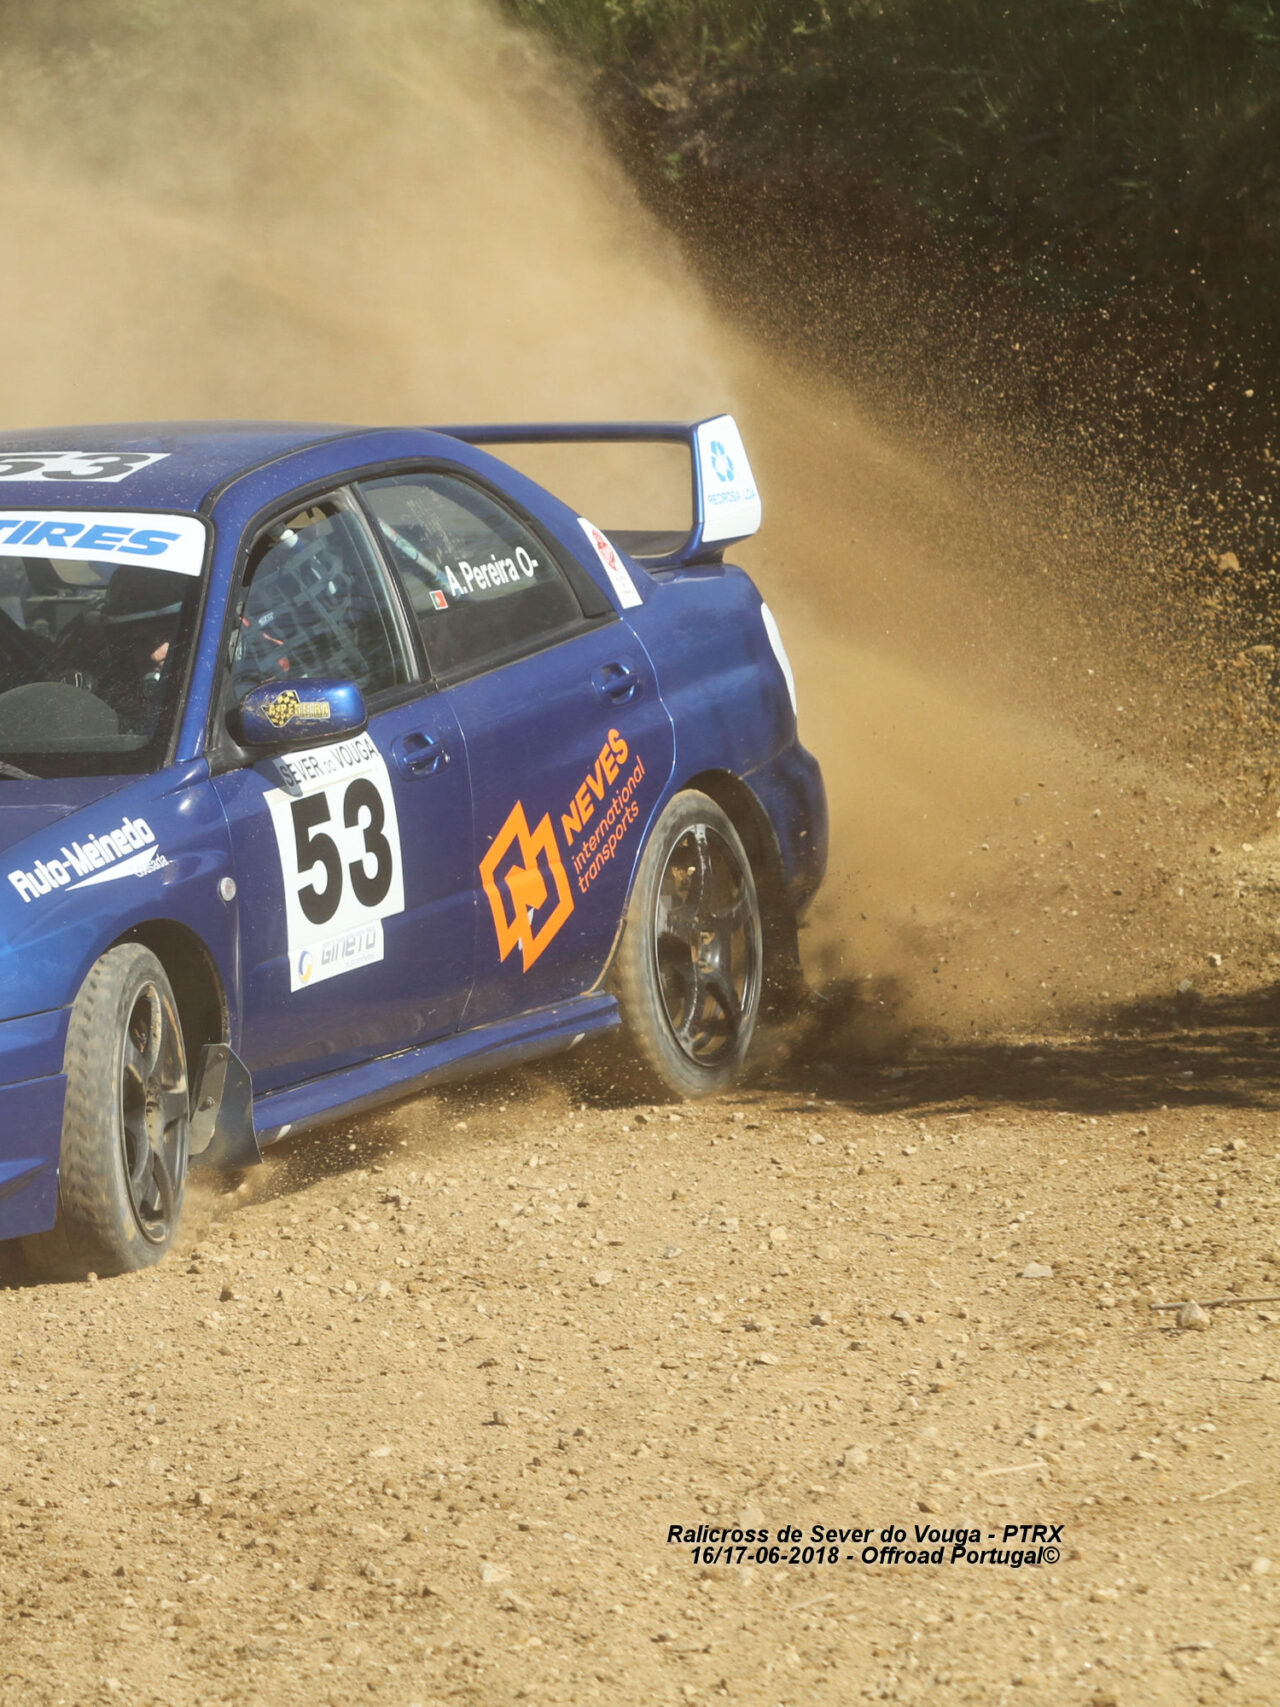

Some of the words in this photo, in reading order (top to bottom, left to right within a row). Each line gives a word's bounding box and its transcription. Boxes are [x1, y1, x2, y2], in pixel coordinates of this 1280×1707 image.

[444, 553, 520, 597] A.Pereira
[280, 755, 326, 788] SEVER
[330, 737, 379, 769] VOUGA
[560, 728, 629, 847] NEVES
[7, 816, 156, 903] Auto-Meinedo
[290, 778, 394, 926] 53
[571, 755, 646, 875] international
[578, 800, 640, 893] transports
